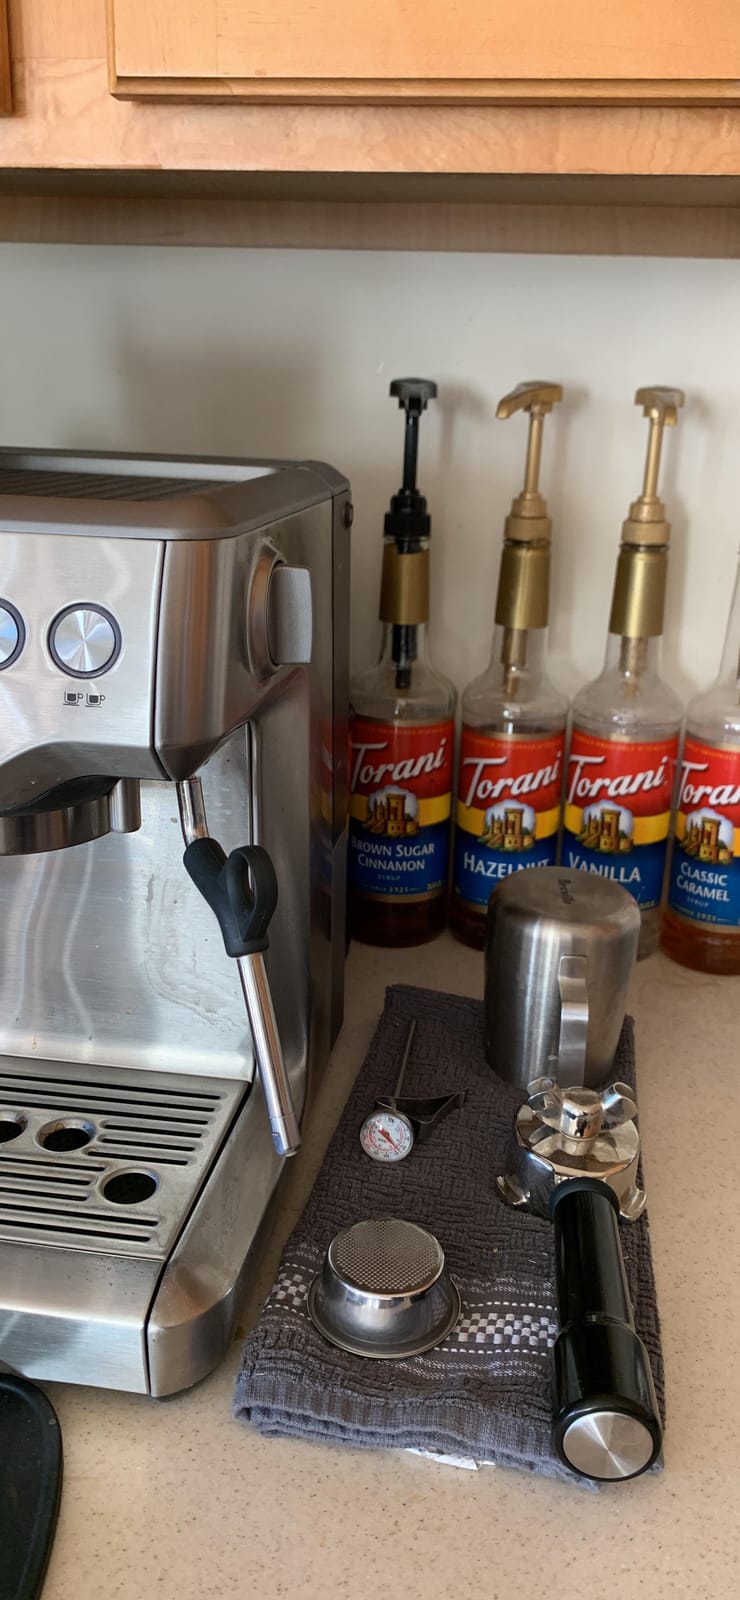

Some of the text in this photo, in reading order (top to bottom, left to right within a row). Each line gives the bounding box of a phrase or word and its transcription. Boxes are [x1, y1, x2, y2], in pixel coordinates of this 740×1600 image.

[351, 737, 446, 793] Torani
[463, 750, 562, 807] Torani
[568, 754, 668, 804] Torani
[676, 760, 740, 809] Tora
[351, 836, 435, 857] BROWN SUGAR
[357, 853, 426, 871] CINNAMON
[569, 851, 641, 883] VANILLA
[680, 861, 728, 887] CLASSIC
[676, 874, 731, 902] CARAMEL
